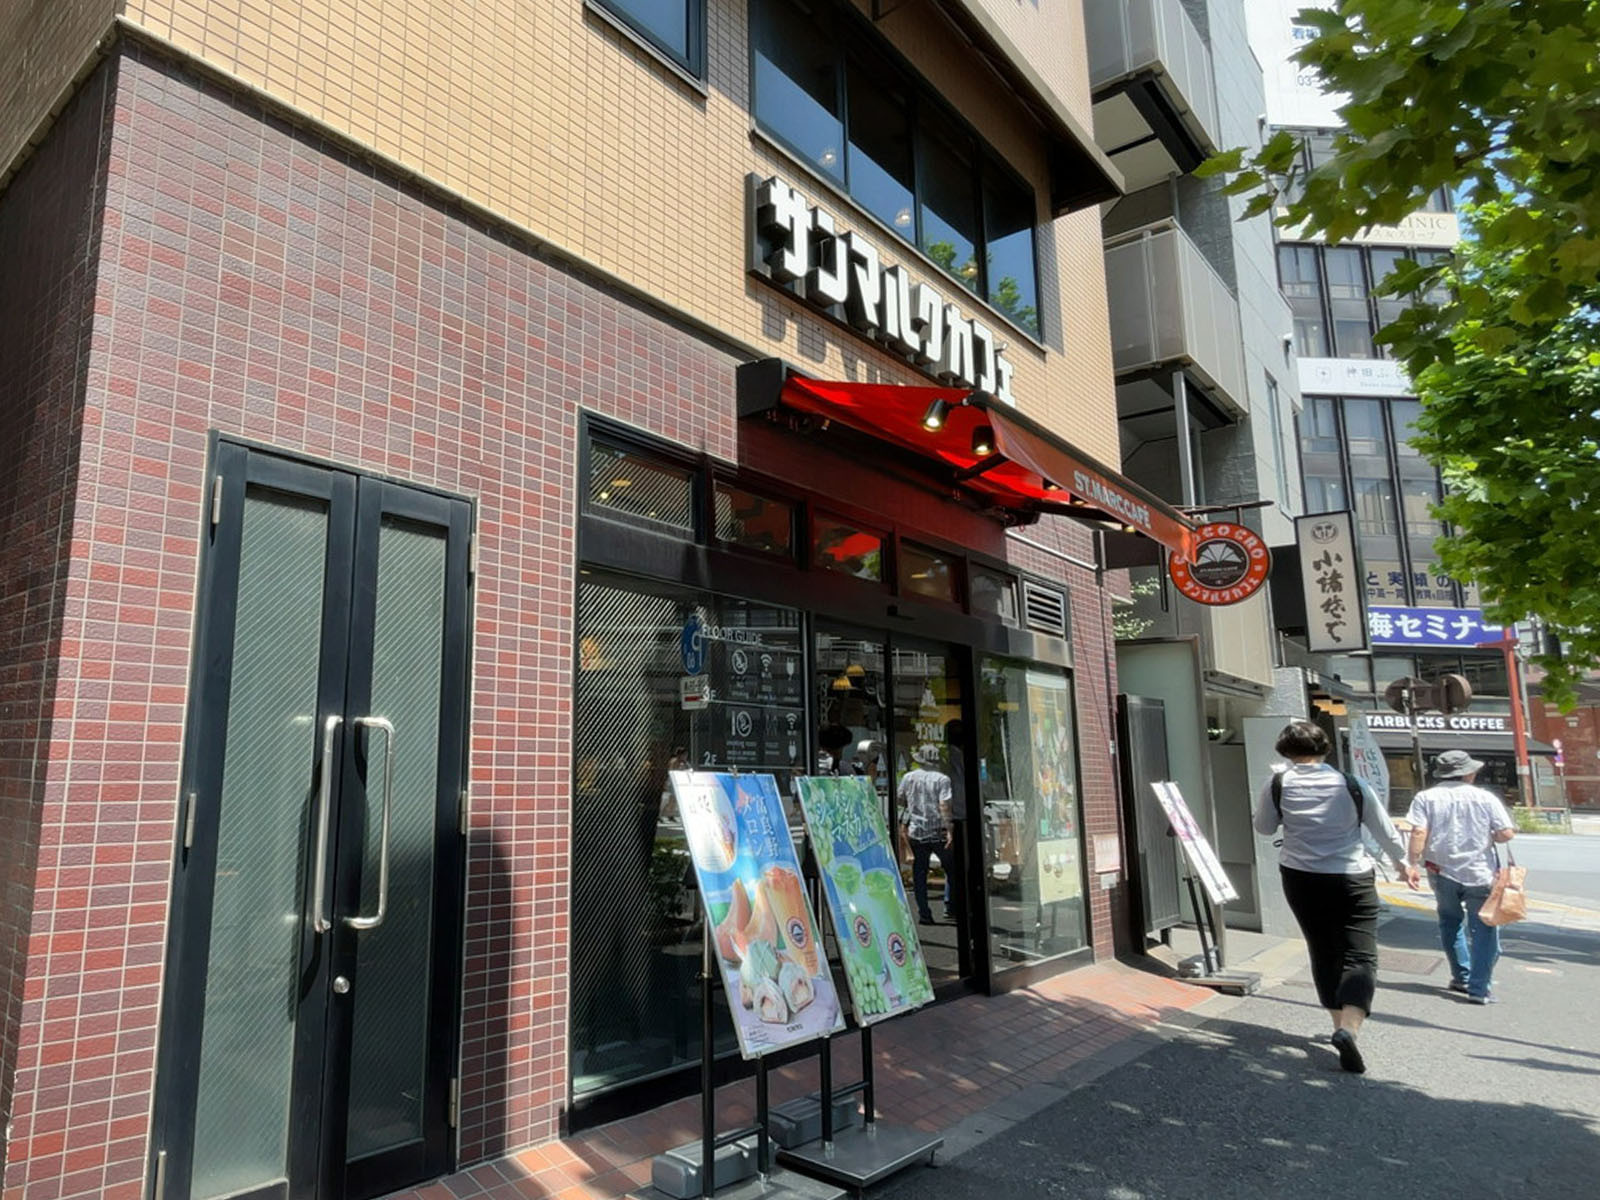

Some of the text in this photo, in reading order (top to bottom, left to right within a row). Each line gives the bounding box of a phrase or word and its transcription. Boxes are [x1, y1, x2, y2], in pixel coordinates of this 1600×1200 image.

[768, 175, 1016, 407] サンマルクカフェ
[1233, 528, 1265, 559] CRO
[702, 624, 763, 646] FLOOR GUIDE
[702, 685, 717, 701] 3F
[1366, 715, 1505, 730] TARBCKS COFFEE
[704, 751, 717, 766] 2F
